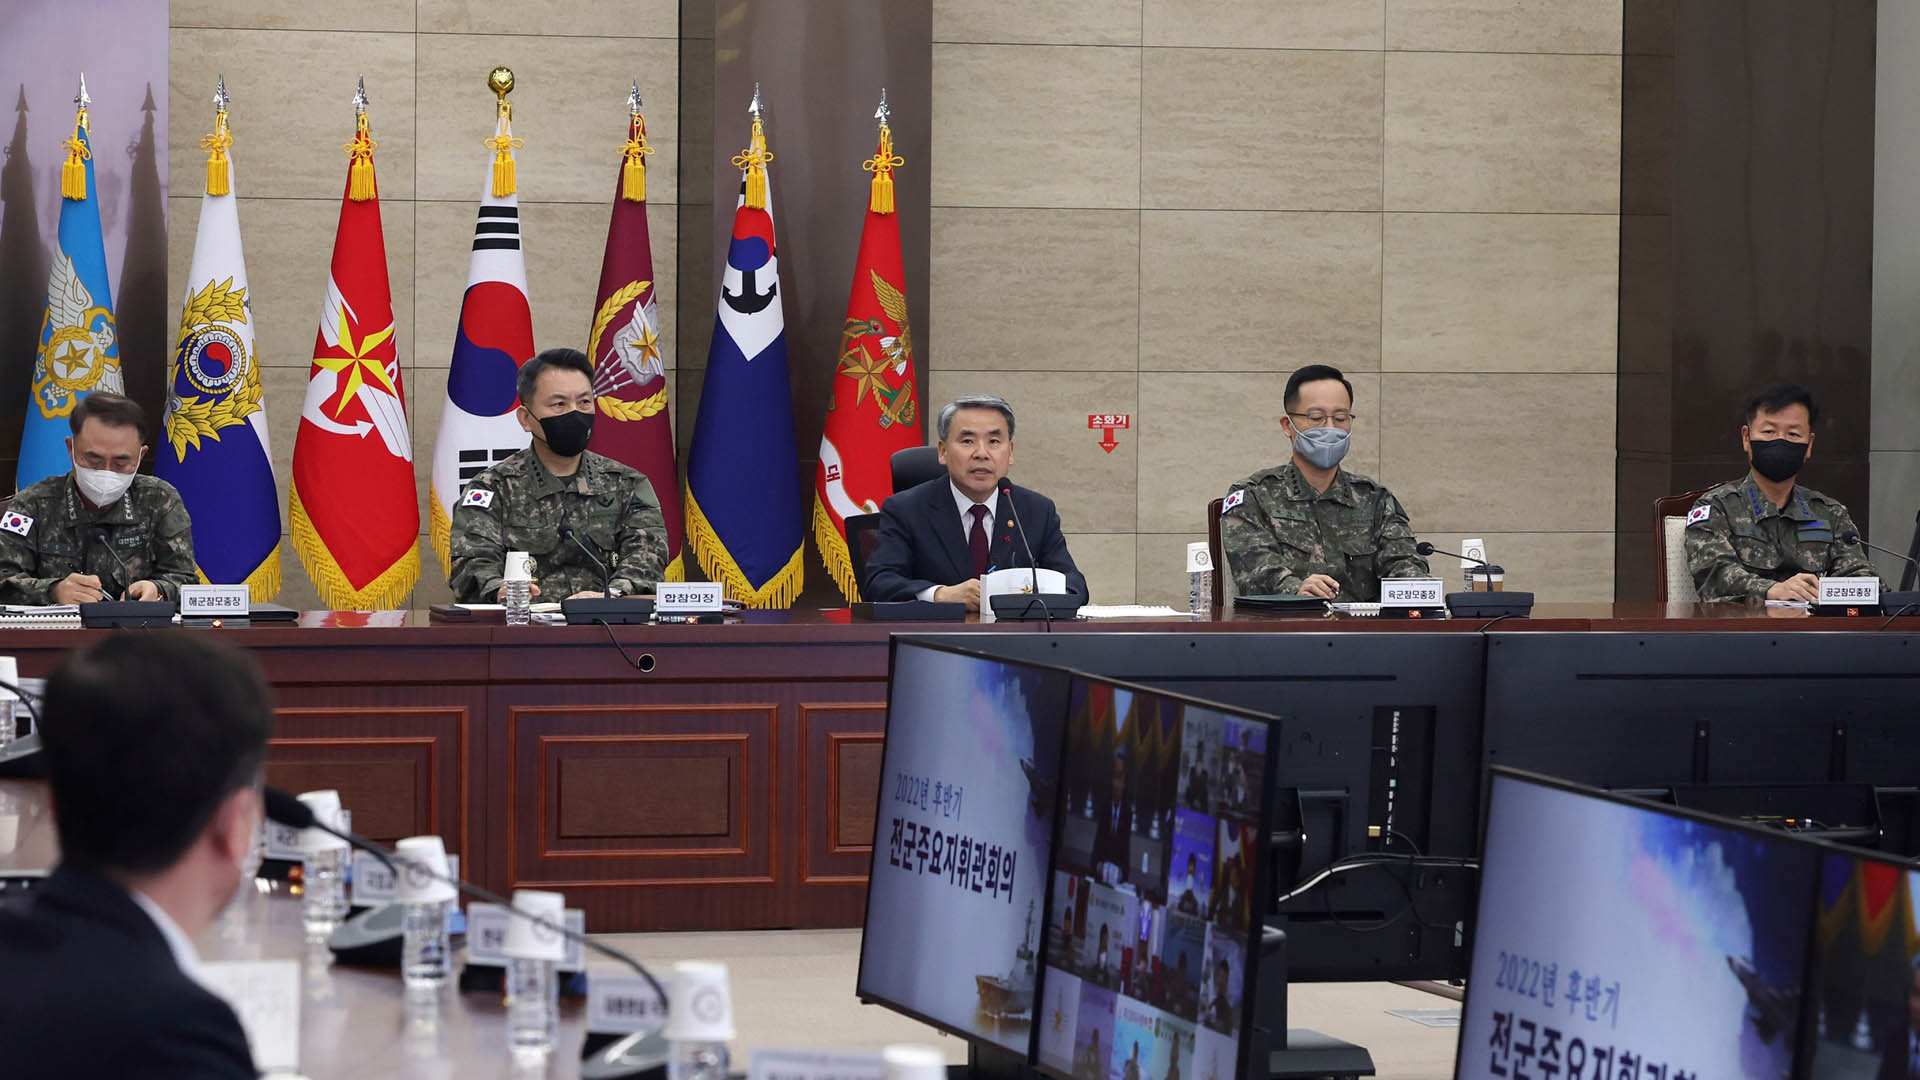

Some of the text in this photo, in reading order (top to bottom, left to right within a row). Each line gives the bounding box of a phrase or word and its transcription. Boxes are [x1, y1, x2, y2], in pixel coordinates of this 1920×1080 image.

[1092, 415, 1127, 424] 소화기
[1388, 590, 1436, 600] 육군참모총장
[1826, 587, 1871, 597] 공군참모총장
[188, 596, 241, 607] 해군참모총장
[664, 593, 714, 603] 합참의장
[895, 773, 963, 822] 2022년 후반기
[890, 817, 1017, 904] 전군주요지휘관회의
[1495, 951, 1621, 1029] 2022년 후반기
